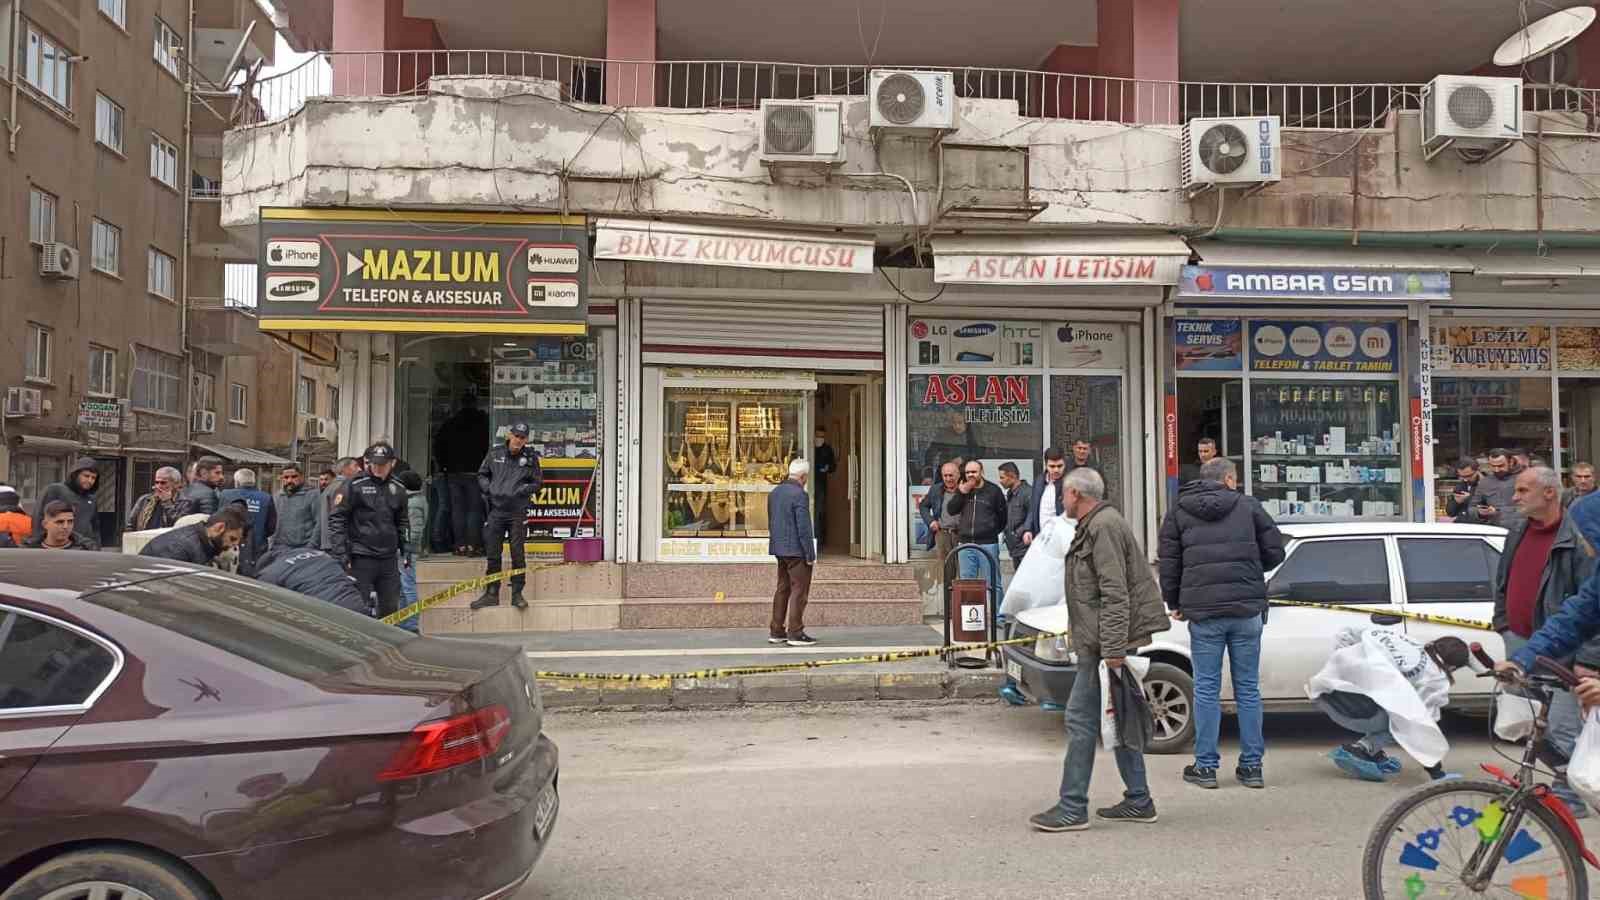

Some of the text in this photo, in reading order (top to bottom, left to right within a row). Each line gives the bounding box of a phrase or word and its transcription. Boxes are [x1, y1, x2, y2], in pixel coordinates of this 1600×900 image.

[1259, 120, 1271, 174] BEKO
[285, 249, 319, 260] iPhone
[544, 256, 578, 265] HUAWEI
[696, 239, 856, 268] KUYUMCUSU
[362, 249, 500, 282] MAZLUM
[965, 257, 1045, 279] ASLAN
[1227, 274, 1393, 292] AMBAR GSM
[342, 288, 502, 306] TELEFON & AKSESUAR
[931, 325, 948, 336] LG
[1074, 332, 1113, 342] iPhone
[1253, 360, 1300, 370] TELEFON
[1302, 361, 1311, 370] &
[1313, 360, 1353, 371] TABLET
[921, 374, 1030, 406] ASLAN
